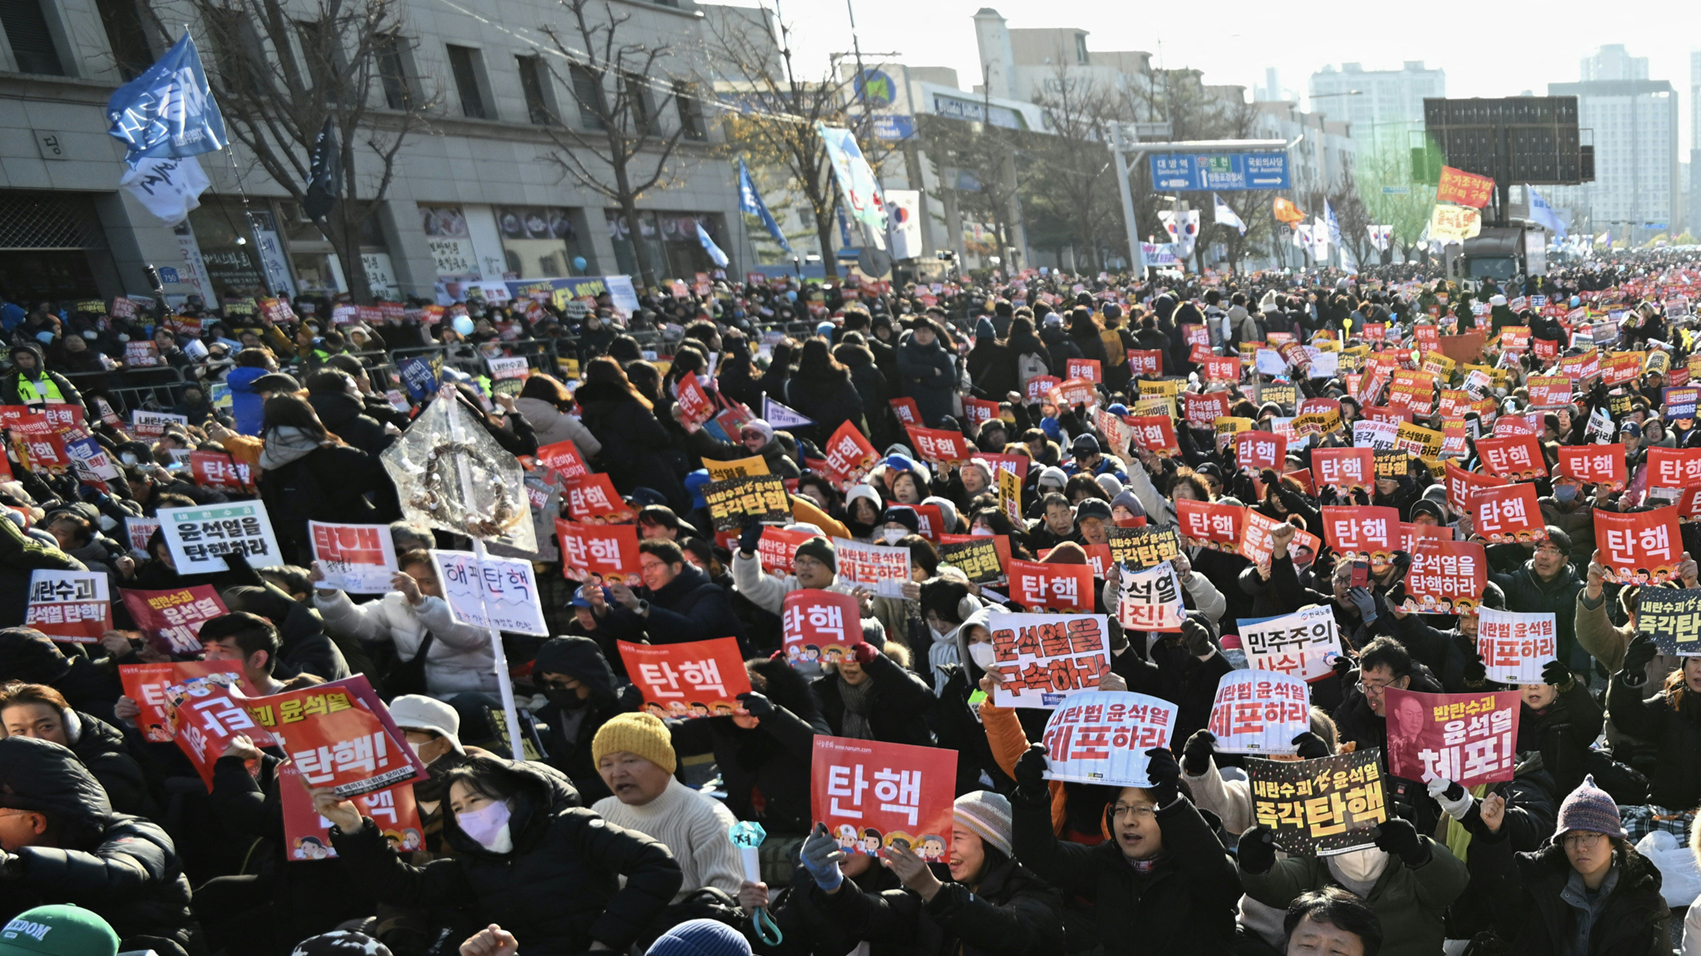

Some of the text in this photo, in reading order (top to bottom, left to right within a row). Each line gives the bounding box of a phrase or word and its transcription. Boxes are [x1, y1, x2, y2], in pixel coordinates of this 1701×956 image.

[1249, 158, 1283, 167] 국회의사당
[1207, 363, 1233, 379] 탄핵
[1132, 427, 1166, 450] 탄핵
[183, 539, 270, 562] 탄핵하라
[1606, 523, 1670, 564] 탄핵
[1411, 552, 1476, 575] 윤석열을
[483, 568, 529, 600] 탄핵
[1020, 574, 1080, 605] 탄핵
[1411, 573, 1477, 598] 탄핵하라
[1641, 598, 1685, 616] 내란수괴
[1247, 617, 1335, 654] 민주주의
[1479, 619, 1553, 641] 내란범 윤석열
[1478, 638, 1555, 668] 체포하라
[639, 657, 728, 698] 탄핵
[998, 652, 1112, 697] 구속하라
[1256, 681, 1304, 702] 윤석열
[1049, 702, 1169, 726] 내란범 윤석열
[1433, 696, 1496, 722] 반란수괴
[1442, 711, 1513, 748] 윤석열
[1418, 733, 1512, 783] 체포!
[1253, 760, 1380, 799] 내란수괴 윤석열
[827, 763, 922, 826] 탄핵
